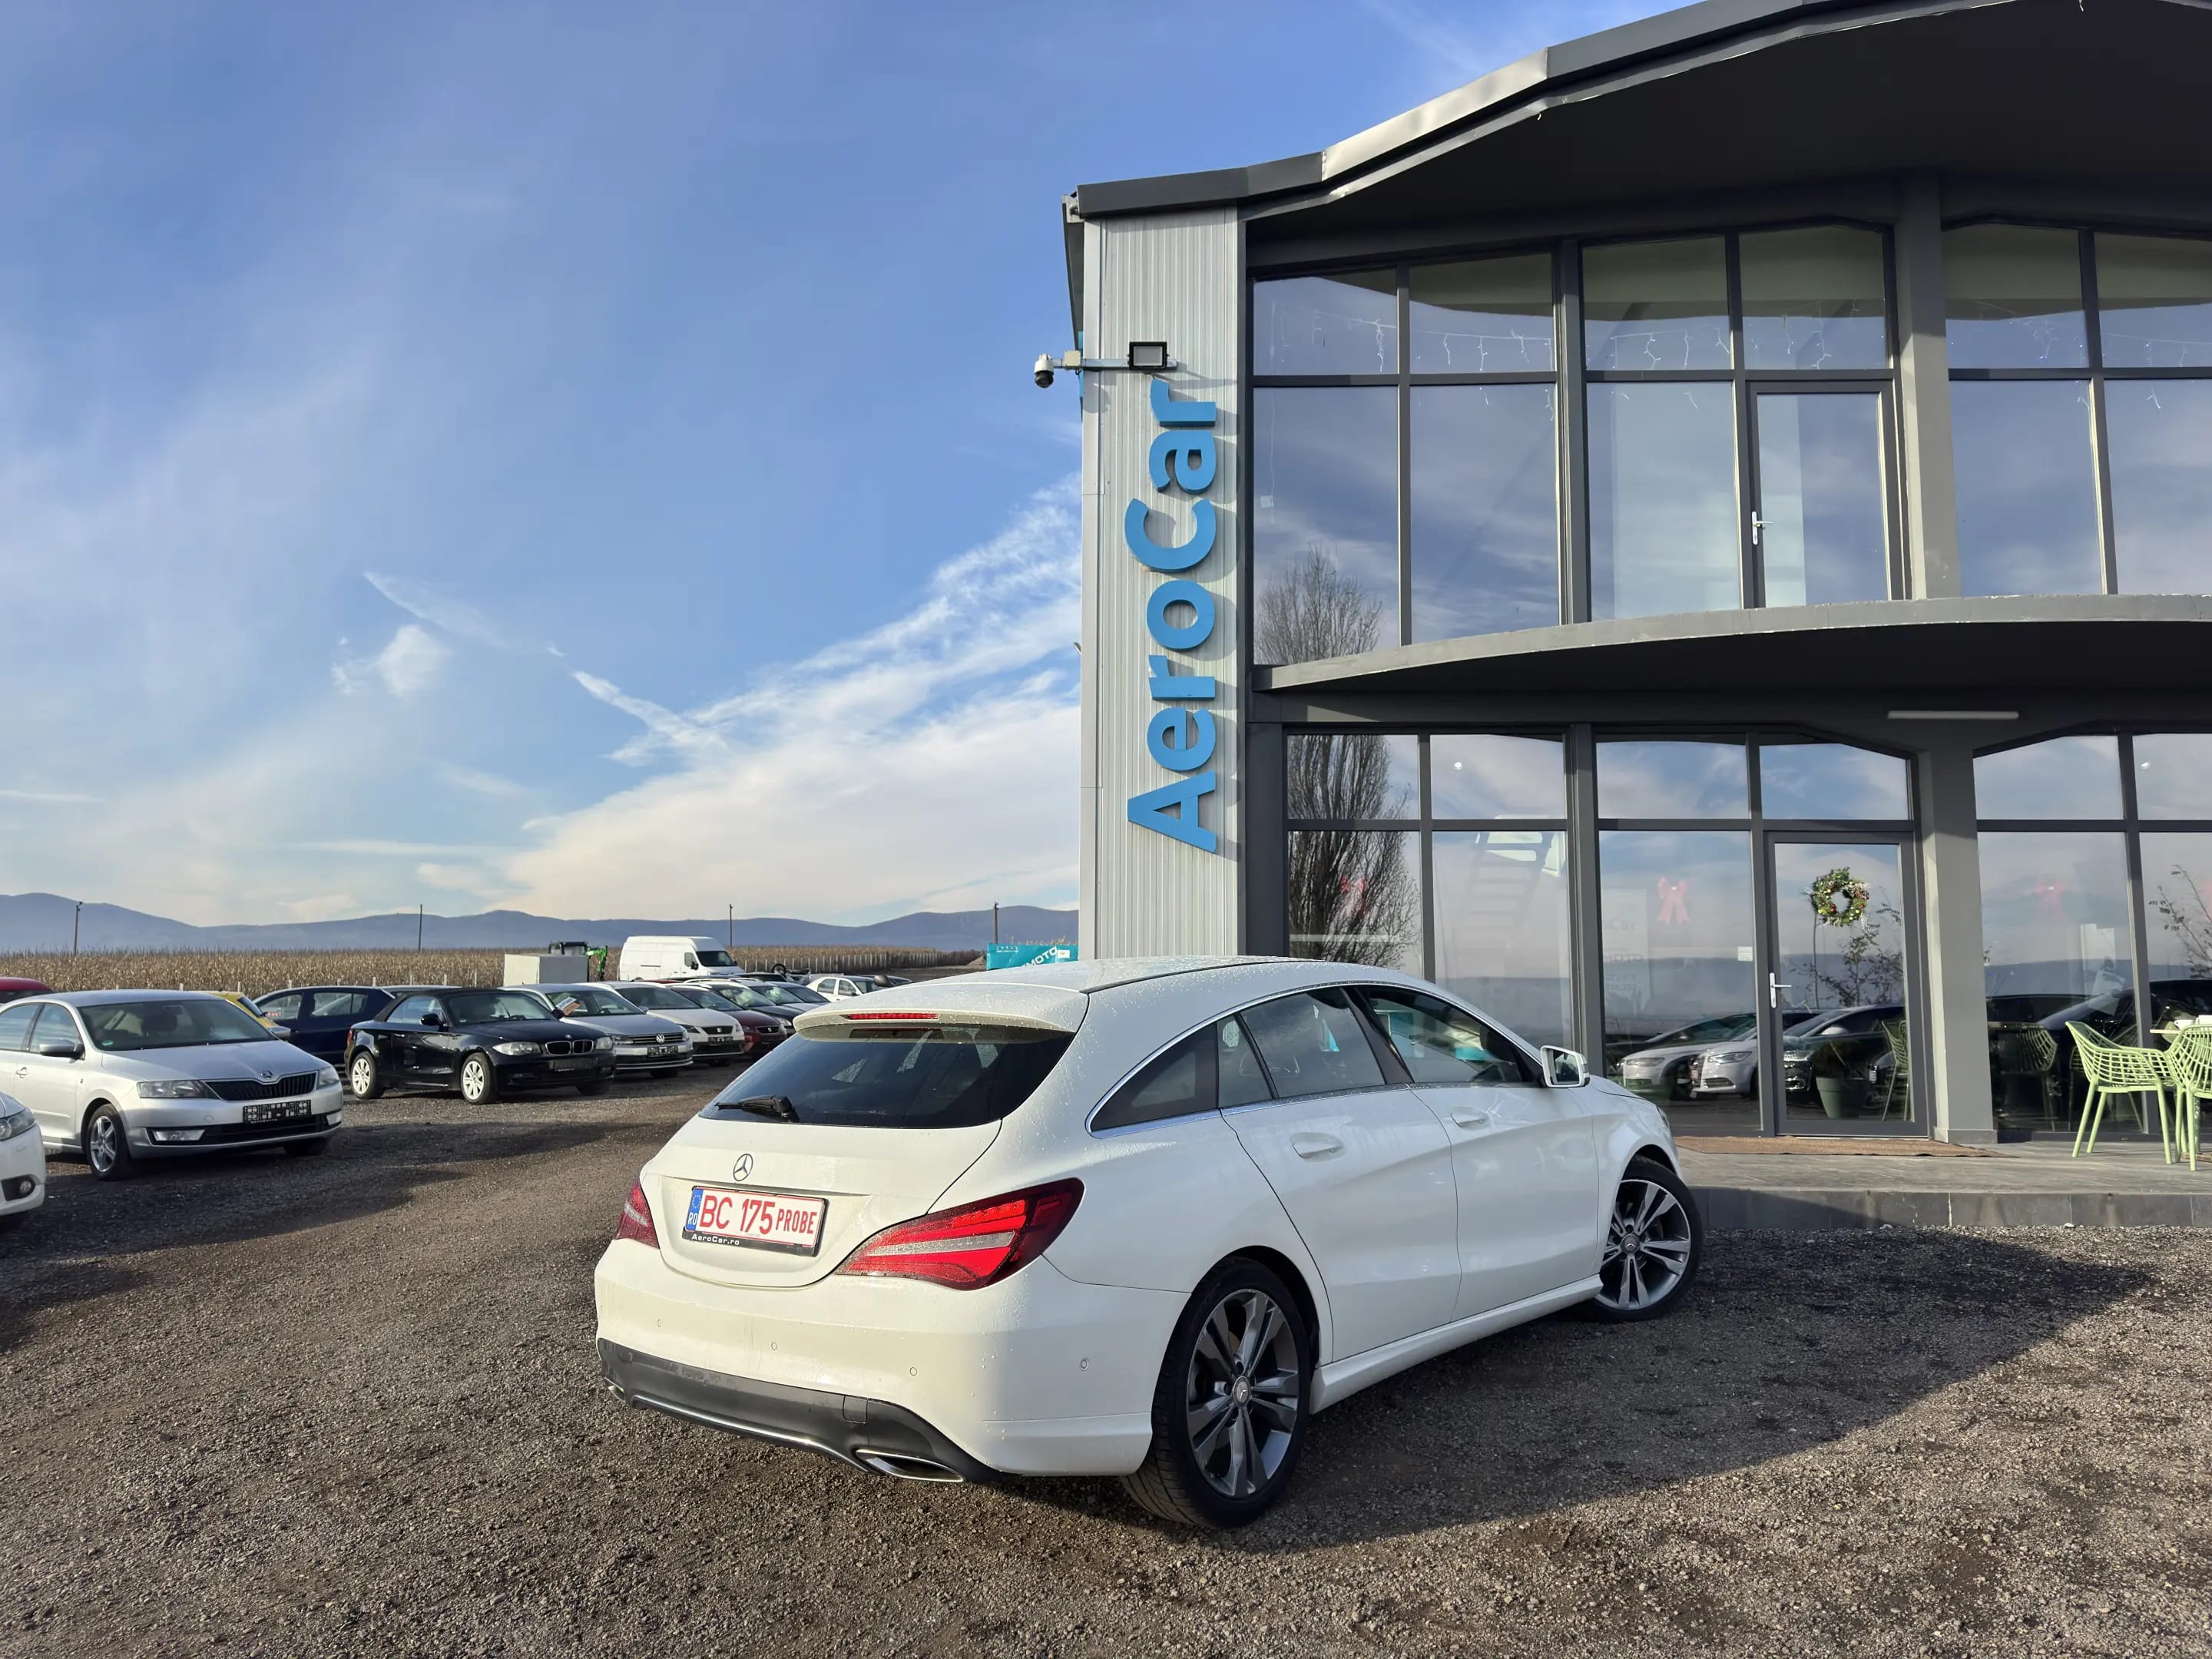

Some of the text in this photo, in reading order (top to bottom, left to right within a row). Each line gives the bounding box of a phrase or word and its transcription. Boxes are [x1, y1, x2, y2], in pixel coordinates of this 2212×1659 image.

[1124, 379, 1217, 853] AeroCar
[687, 1212, 698, 1226] RO
[700, 1195, 817, 1235] BC 175 PROBE
[691, 1233, 740, 1246] AeroCar.ro
